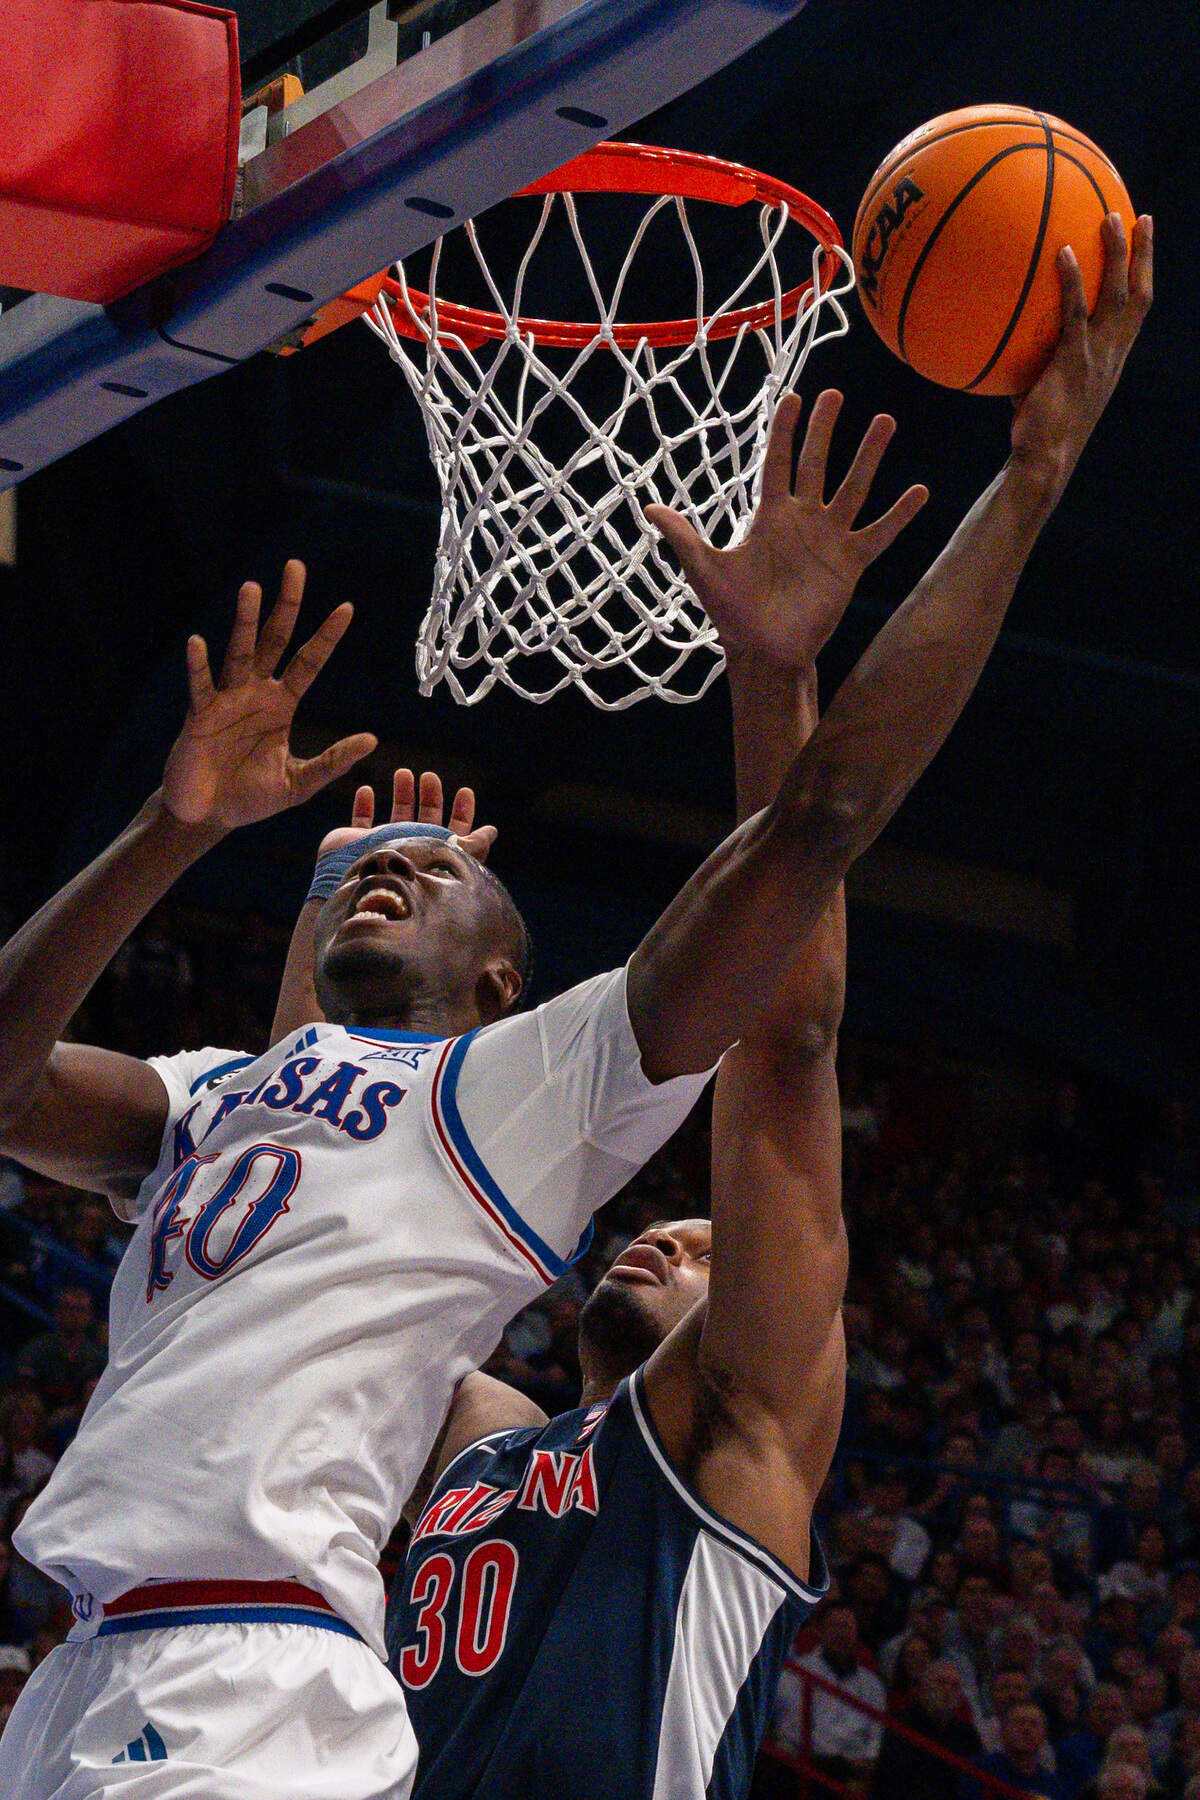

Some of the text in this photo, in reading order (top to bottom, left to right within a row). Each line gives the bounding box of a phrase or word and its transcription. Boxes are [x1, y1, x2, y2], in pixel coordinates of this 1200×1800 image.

[173, 1057, 408, 1172] KASAS
[147, 1142, 301, 1304] 40
[400, 1538, 519, 1691] 30
